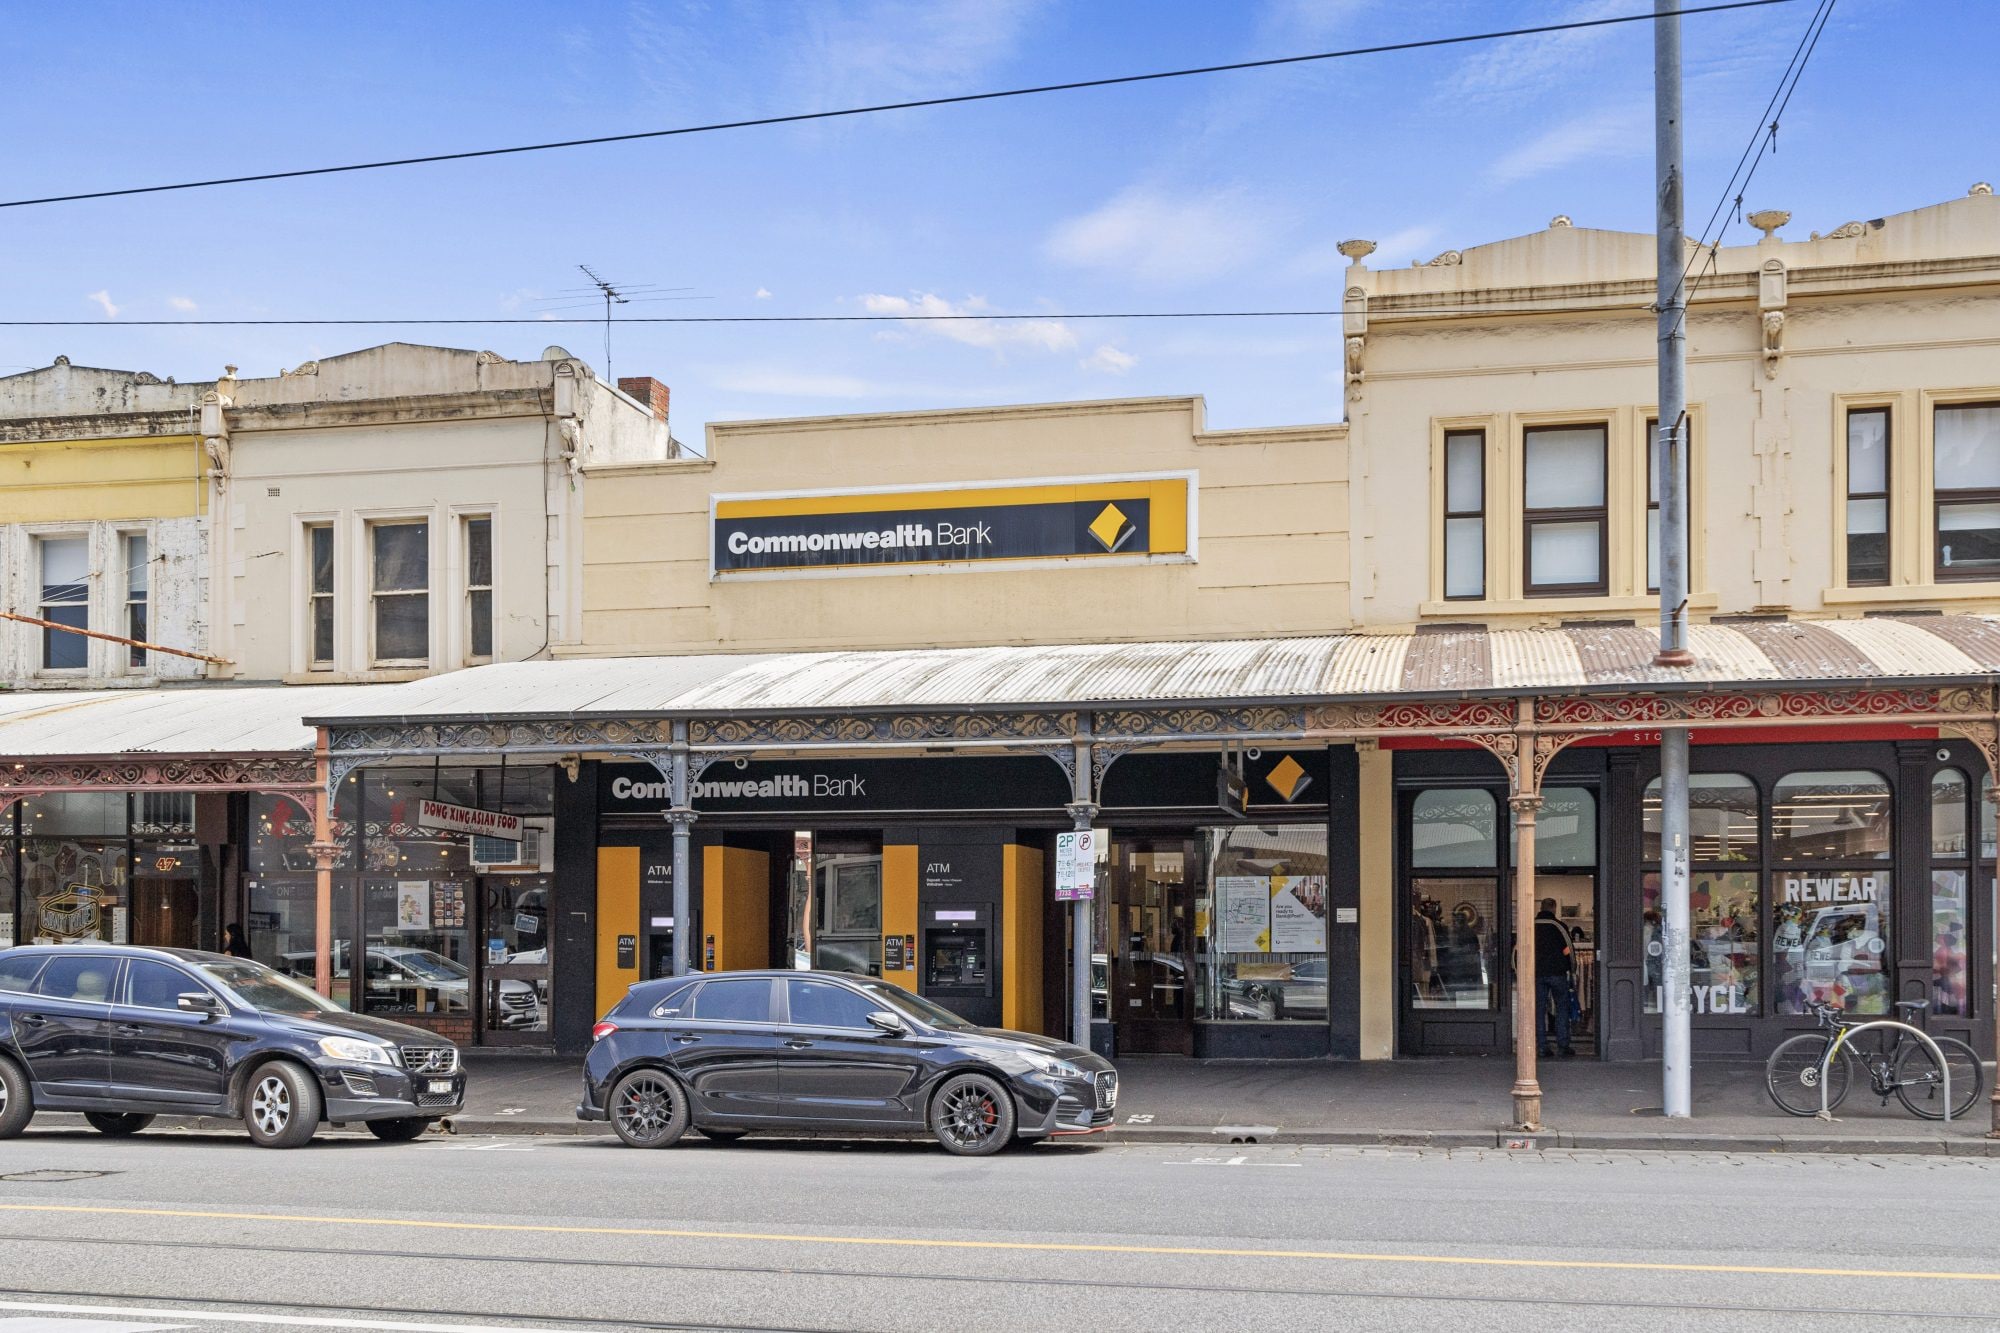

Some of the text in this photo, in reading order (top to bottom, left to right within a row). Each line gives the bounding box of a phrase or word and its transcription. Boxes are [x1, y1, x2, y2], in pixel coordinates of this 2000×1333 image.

[728, 521, 992, 554] Commonwealth Bank
[1634, 732, 1694, 741] STOS
[612, 773, 866, 799] Comonwealth Bank
[424, 802, 447, 820] DONG
[450, 806, 470, 825] XING
[471, 811, 495, 828] ASIAN
[497, 815, 517, 830] FOOD
[1059, 835, 1074, 847] 2P
[156, 857, 175, 871] 47
[648, 865, 672, 875] ATM
[927, 863, 950, 873] ATM
[509, 878, 521, 887] 49
[1785, 877, 1877, 902] REWEAR
[886, 938, 903, 946] ATM
